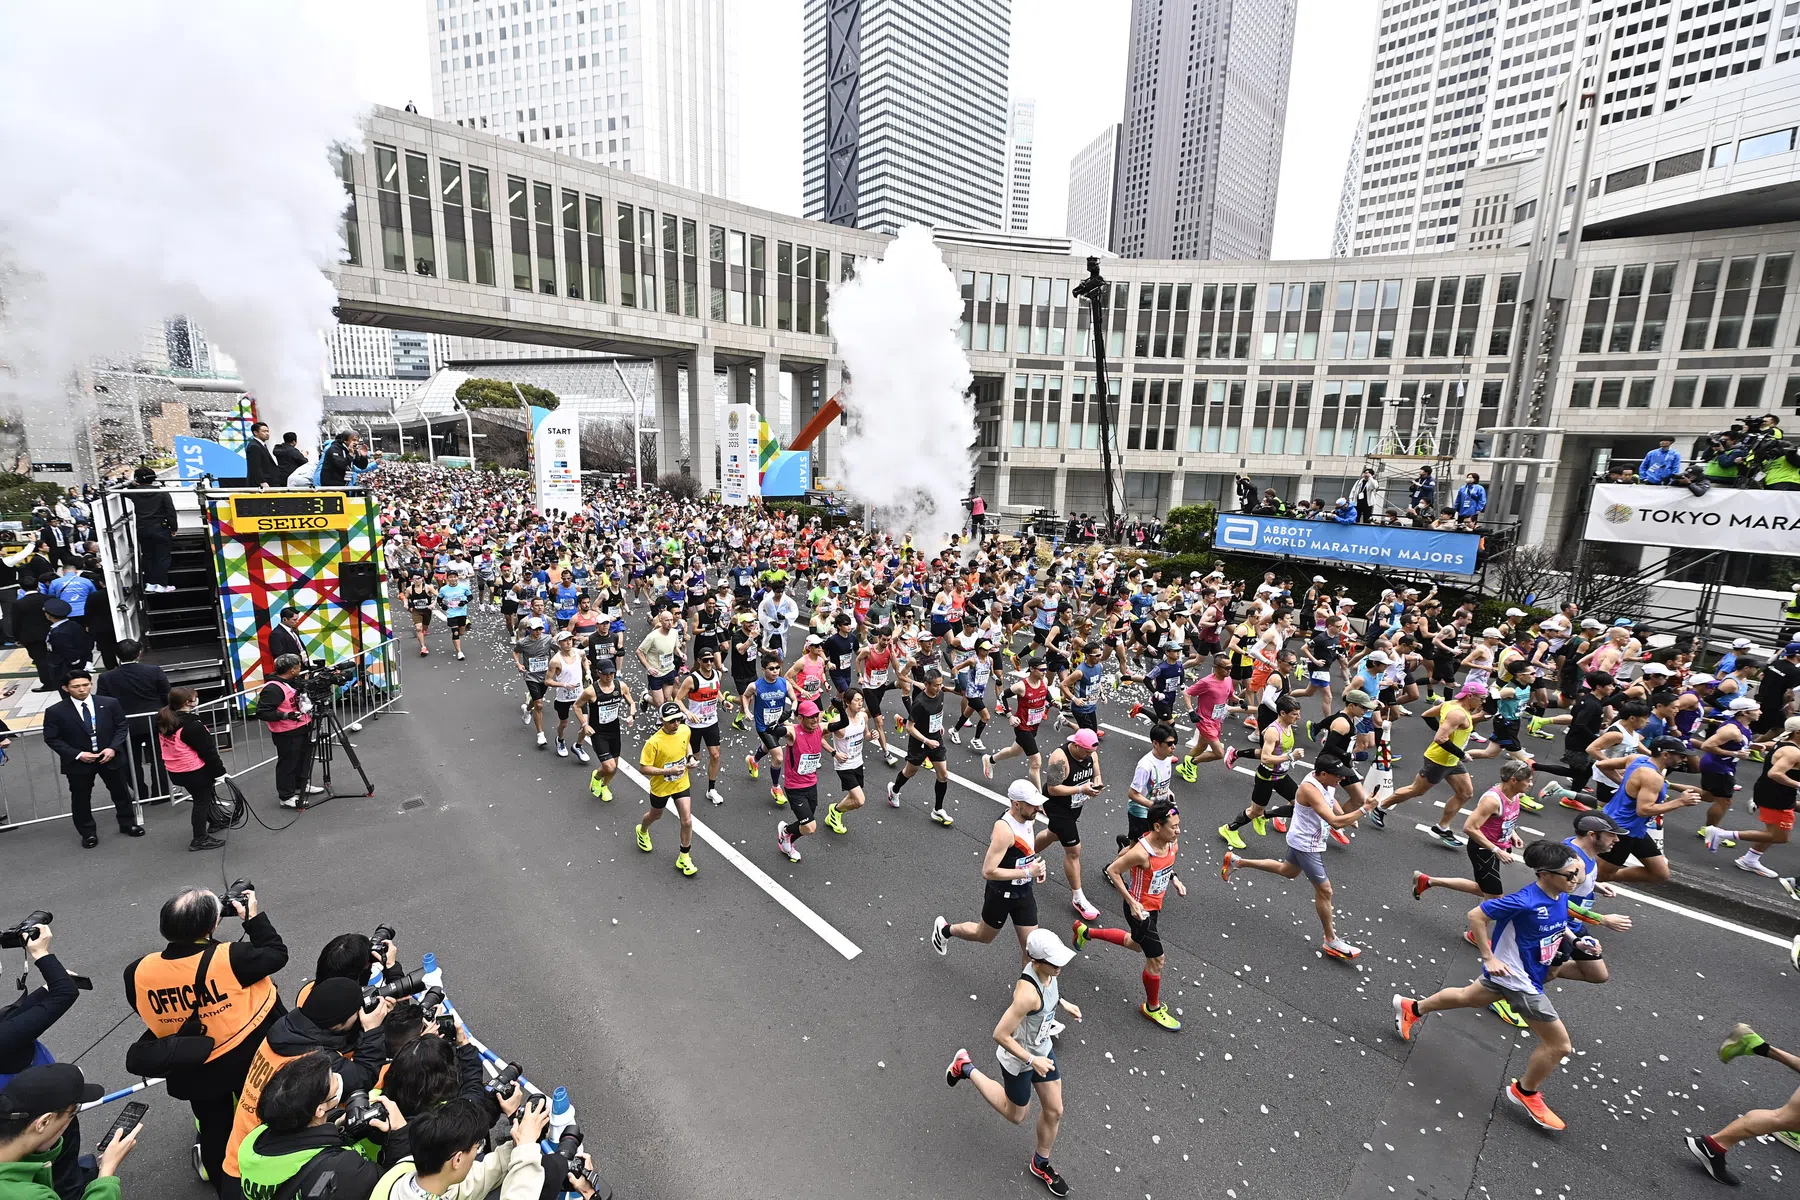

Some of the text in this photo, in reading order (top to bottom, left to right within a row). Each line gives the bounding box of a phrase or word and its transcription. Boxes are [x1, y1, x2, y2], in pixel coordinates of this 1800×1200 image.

[547, 427, 572, 435] START
[183, 445, 204, 481] STA
[800, 456, 808, 490] START
[257, 516, 328, 531] SEIKO
[1638, 508, 1721, 526] TOKYO
[1263, 525, 1313, 538] ABBOTT
[1263, 536, 1464, 565] WORLD MARATHON MAJORS
[185, 1003, 232, 1022] RATHON
